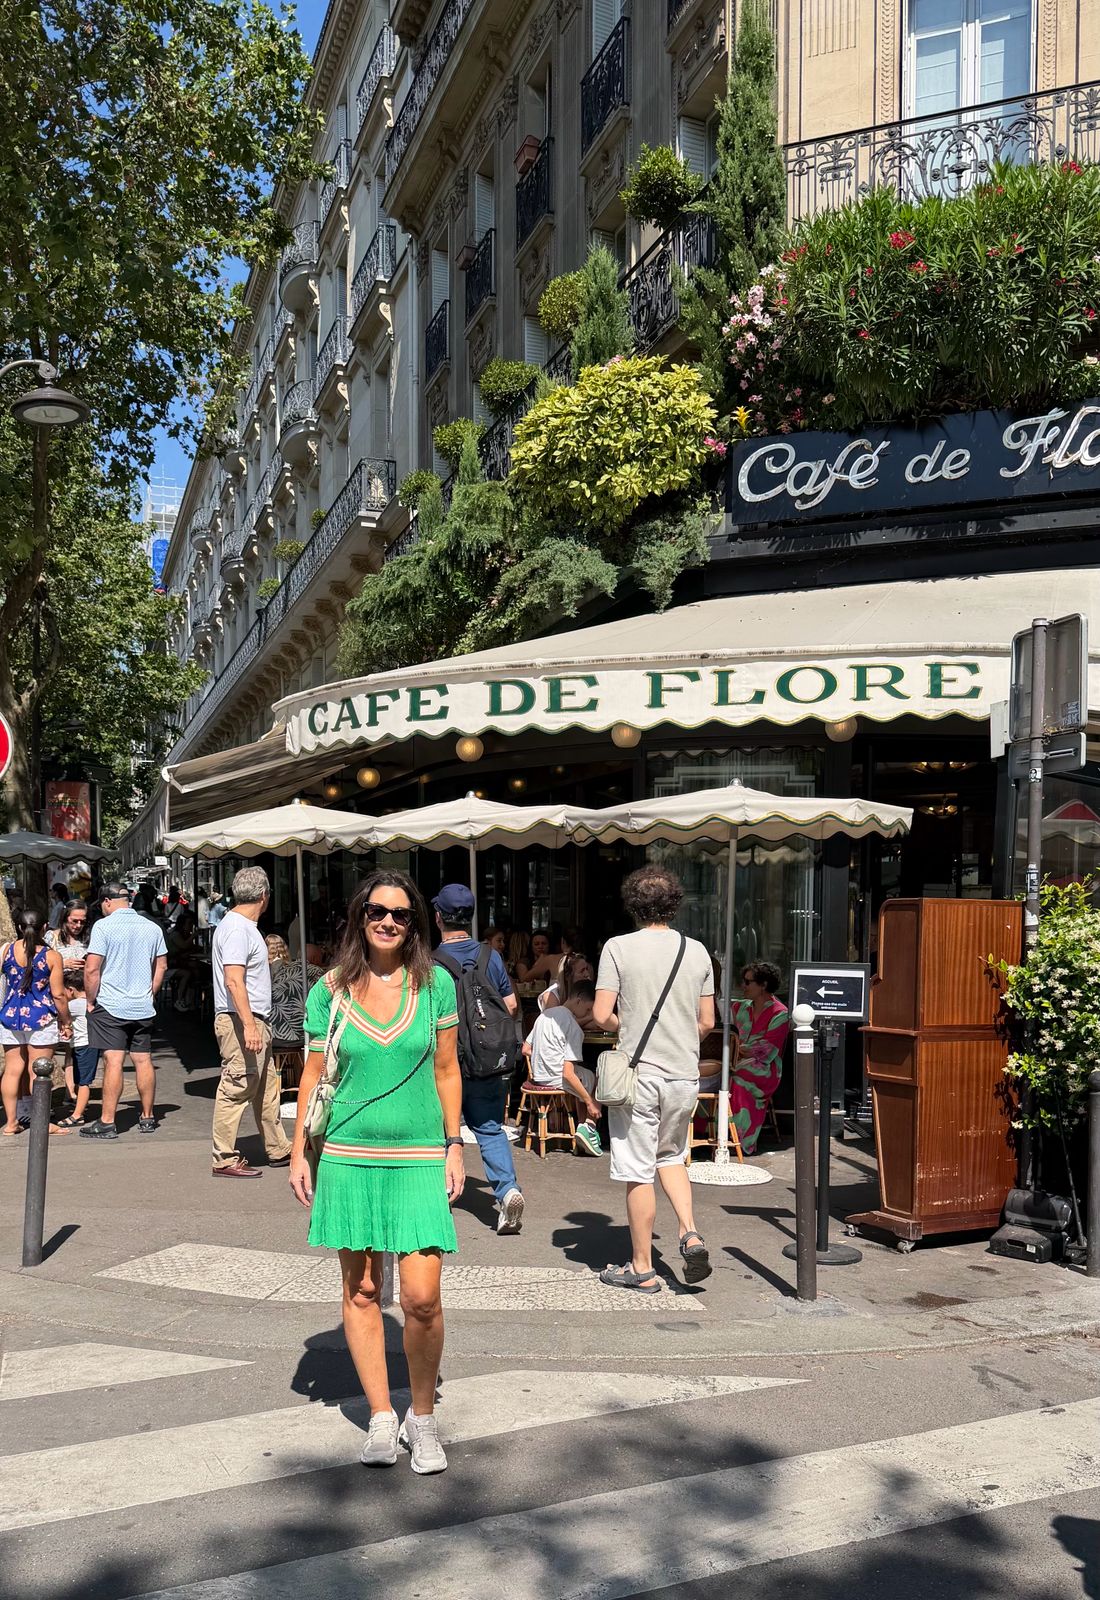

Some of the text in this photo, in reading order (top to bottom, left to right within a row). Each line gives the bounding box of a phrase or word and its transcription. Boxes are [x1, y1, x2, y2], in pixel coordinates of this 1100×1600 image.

[737, 438, 891, 510] Café
[904, 439, 970, 484] de
[307, 661, 983, 737] CAFE DE FLORE
